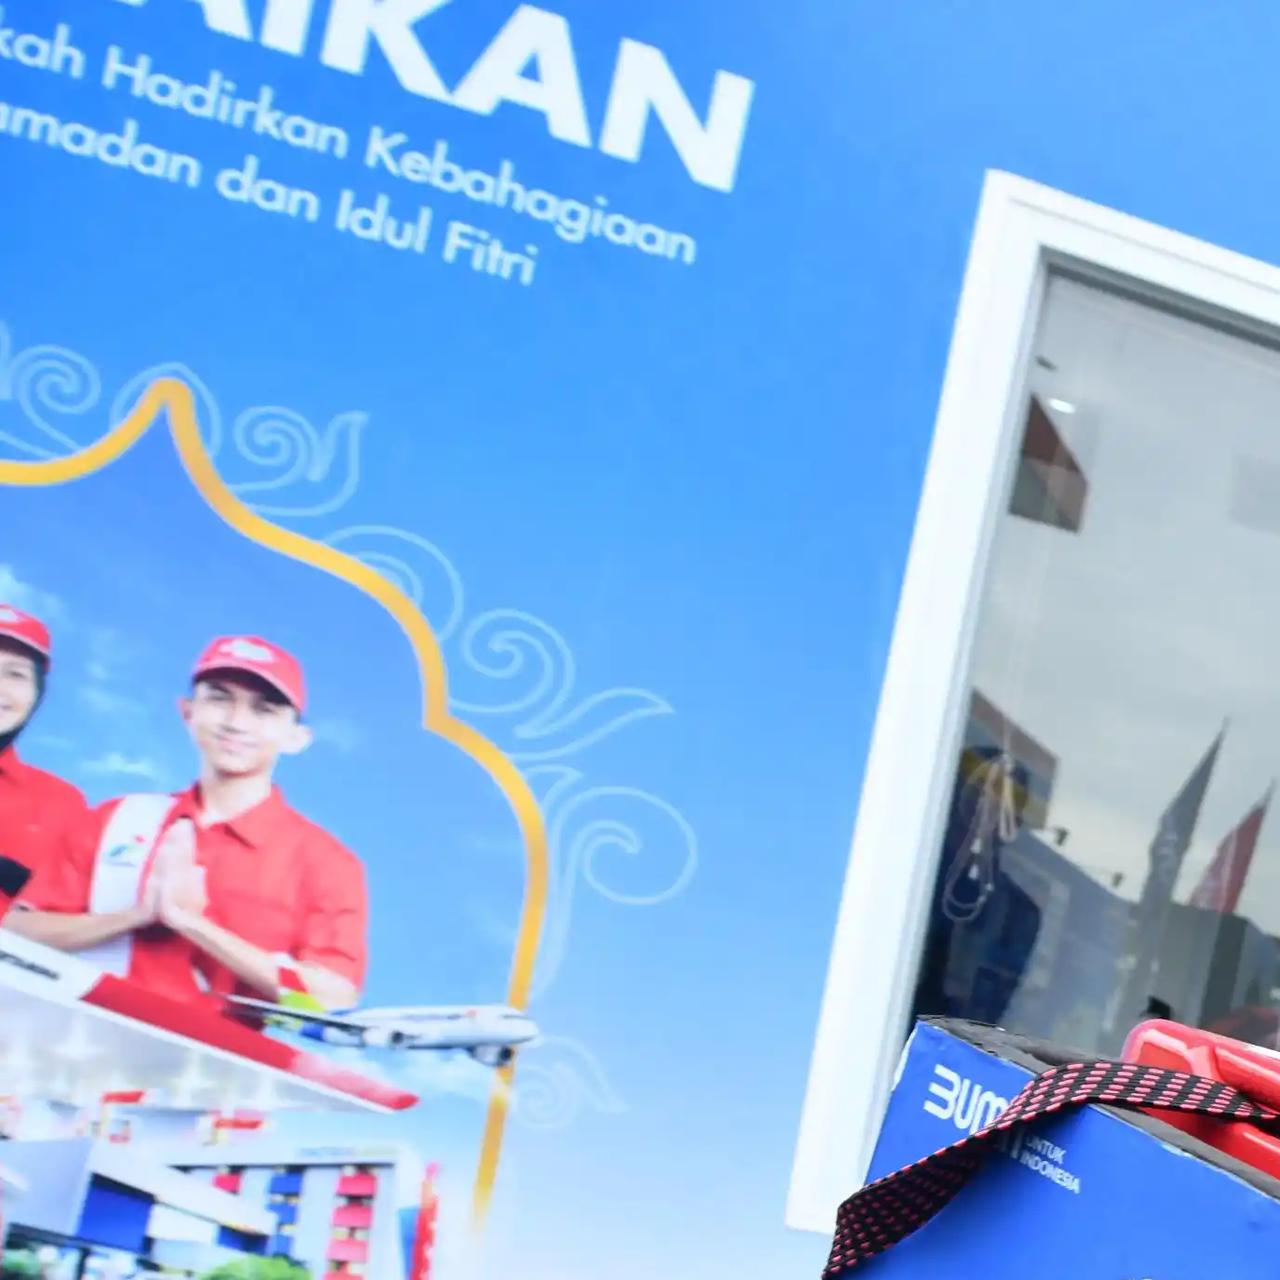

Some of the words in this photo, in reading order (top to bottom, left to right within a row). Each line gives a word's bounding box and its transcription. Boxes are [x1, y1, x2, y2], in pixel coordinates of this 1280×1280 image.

[0, 103, 200, 188] madan
[214, 153, 320, 222] dan
[335, 189, 432, 254] Idul
[442, 220, 538, 286] Fitri
[102, 44, 349, 159] Hadirkan
[364, 125, 697, 264] Kebahagiaan
[1019, 1150, 1081, 1195] INDONESIA
[1025, 1134, 1067, 1165] UNTUK
